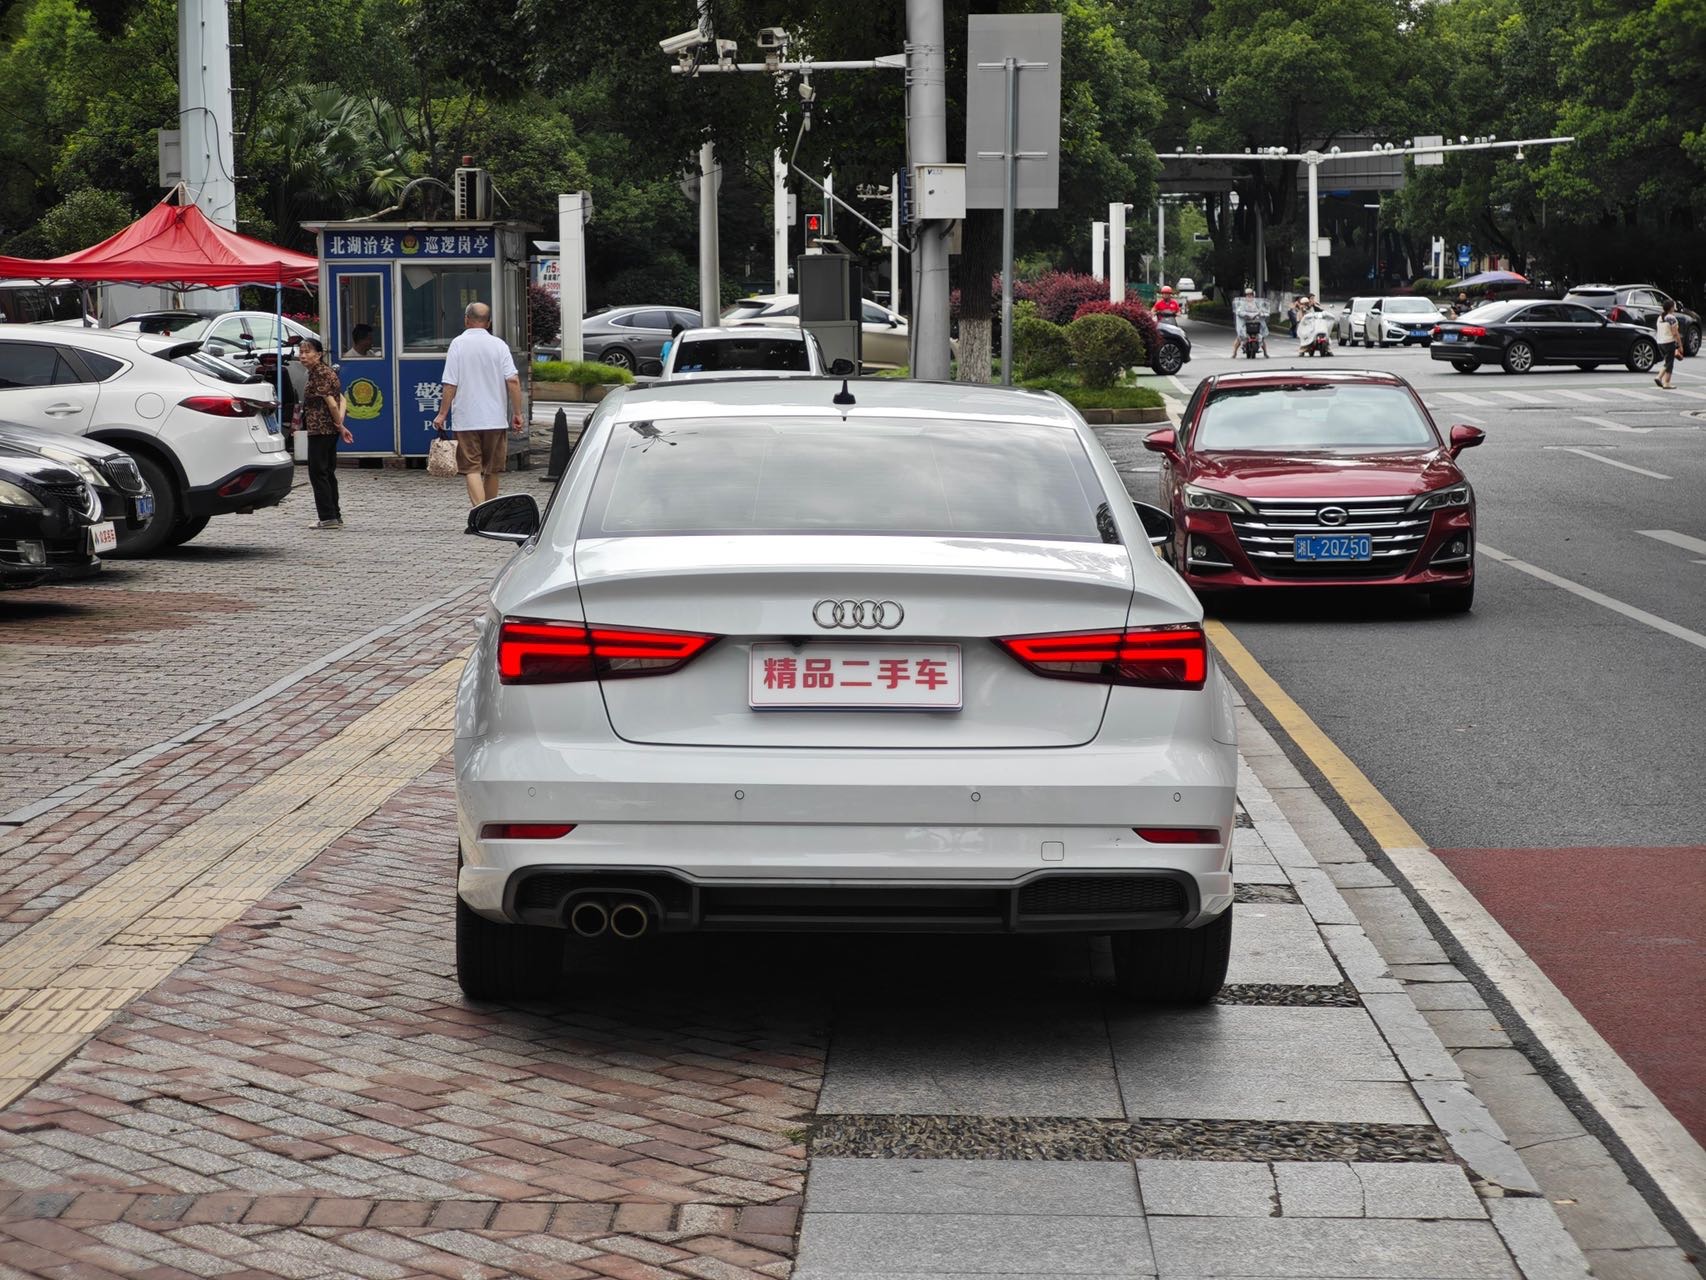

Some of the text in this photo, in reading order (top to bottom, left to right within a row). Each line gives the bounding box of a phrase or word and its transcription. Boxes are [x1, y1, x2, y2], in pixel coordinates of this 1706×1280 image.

[330, 235, 489, 255] 北湖治安 巡逻岗亭
[763, 657, 949, 690] 精品二手车
